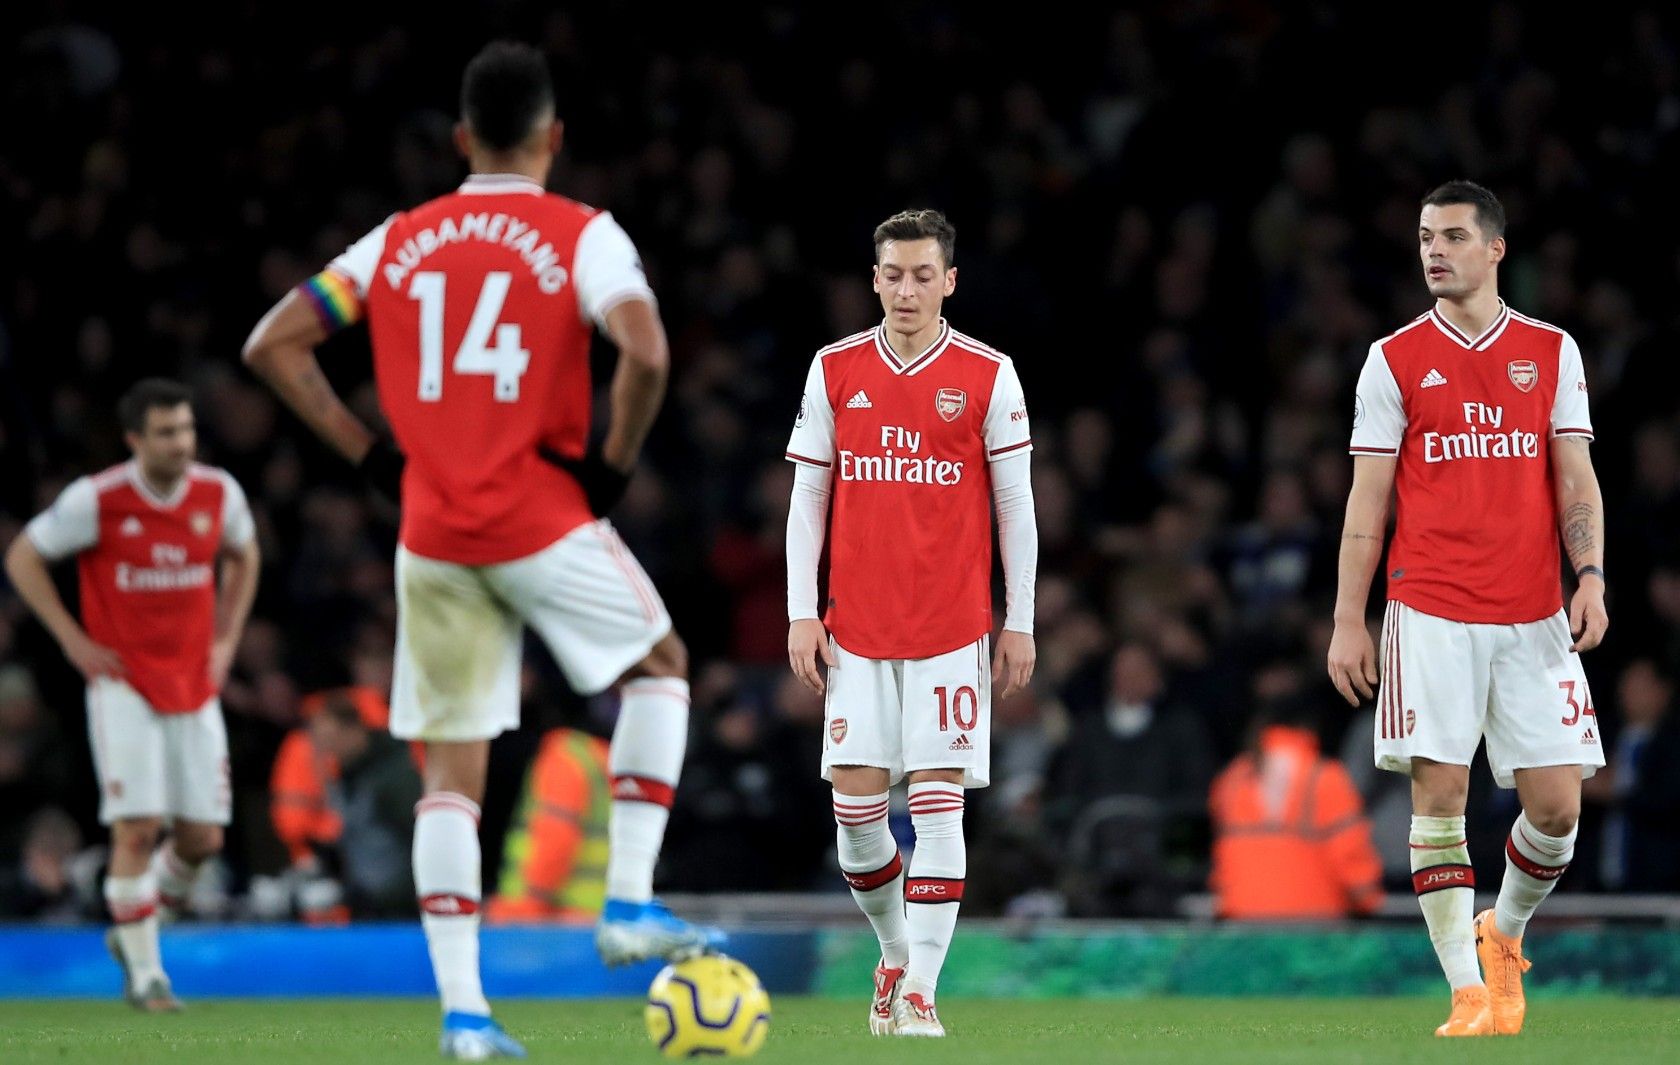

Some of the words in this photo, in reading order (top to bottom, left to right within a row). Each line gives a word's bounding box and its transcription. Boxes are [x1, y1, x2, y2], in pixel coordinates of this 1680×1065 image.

[384, 213, 568, 294] AUBAMEYANG
[408, 271, 531, 402] 14
[1420, 377, 1448, 389] adidas
[846, 401, 873, 409] adidas
[1462, 402, 1503, 429] Fly
[881, 425, 921, 454] Fly
[840, 449, 964, 486] Emirates
[933, 685, 978, 731] 10
[1558, 680, 1597, 726] 34
